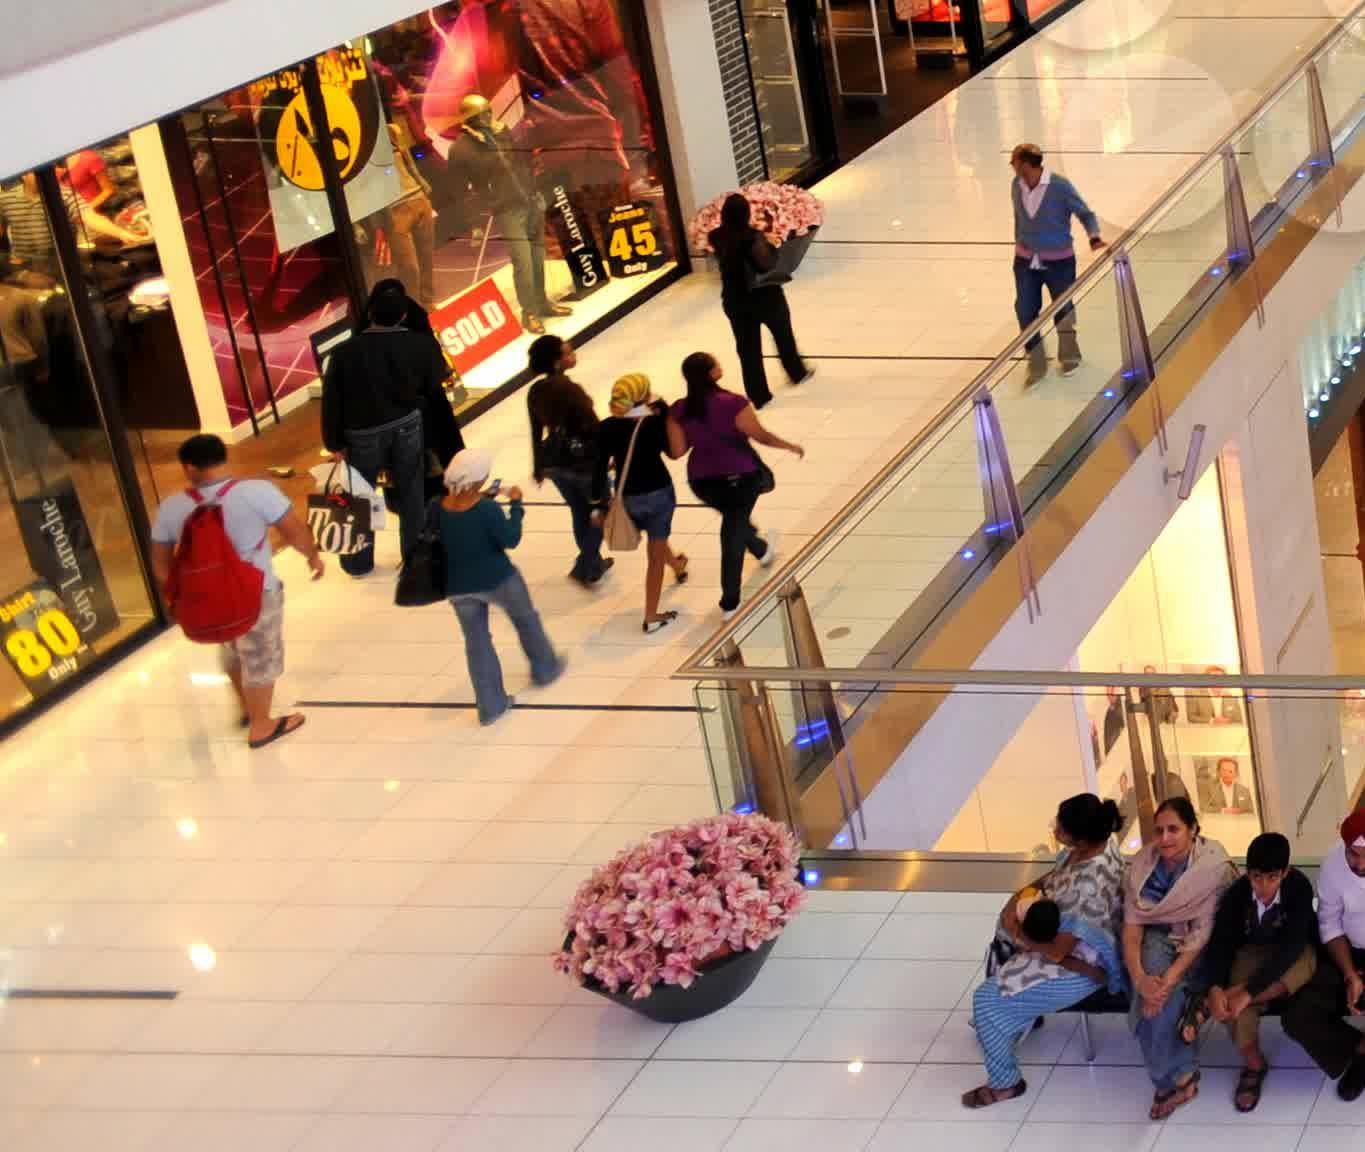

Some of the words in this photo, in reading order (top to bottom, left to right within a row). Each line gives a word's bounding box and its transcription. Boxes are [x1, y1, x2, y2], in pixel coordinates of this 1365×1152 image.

[553, 185, 586, 253] Laroche
[609, 221, 657, 260] 45
[579, 253, 598, 288] Guy
[623, 262, 648, 274] Only
[440, 300, 507, 357] SOLD
[40, 497, 82, 590] Laroche
[306, 508, 353, 555] Toi
[71, 586, 97, 634] Guy
[6, 608, 81, 677] 80
[48, 656, 78, 680] Only
